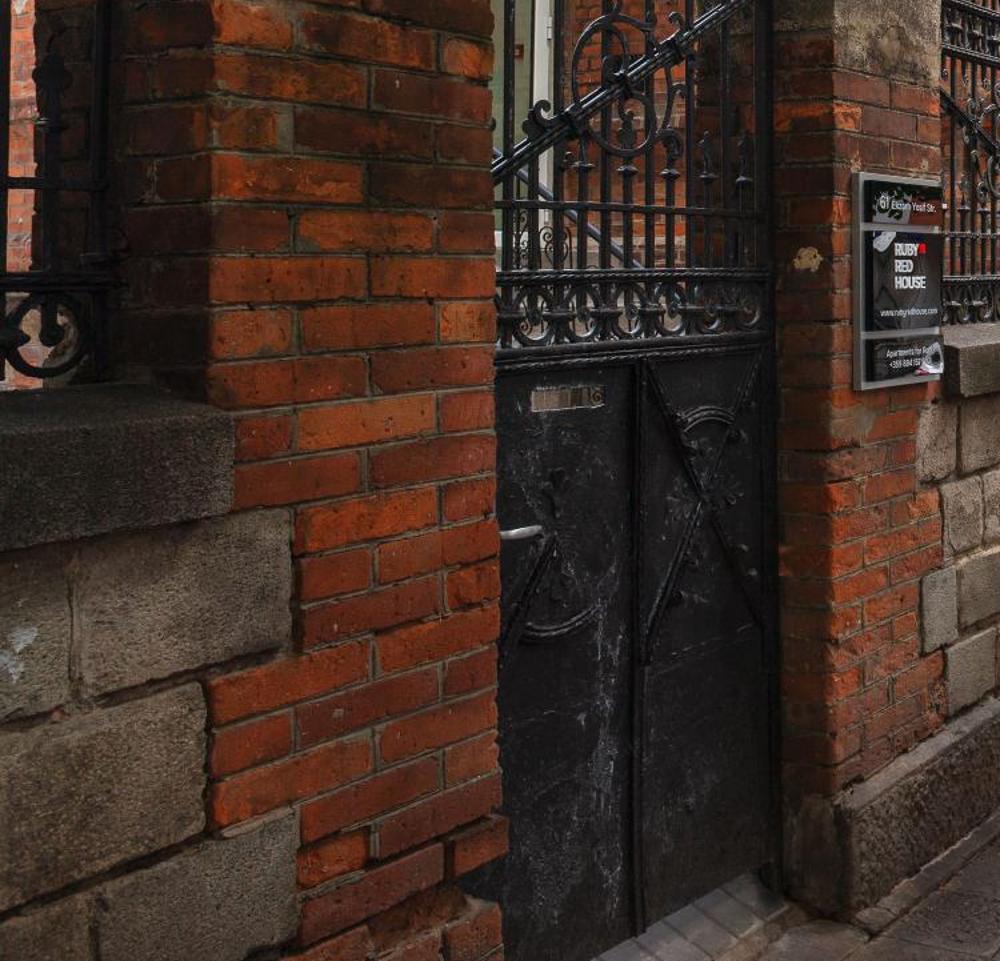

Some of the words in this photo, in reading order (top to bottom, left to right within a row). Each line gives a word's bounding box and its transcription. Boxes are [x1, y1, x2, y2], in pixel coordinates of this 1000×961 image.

[879, 195, 889, 210] 61
[894, 242, 919, 257] RUBY
[894, 259, 914, 273] RED
[894, 276, 927, 289] HOUSE
